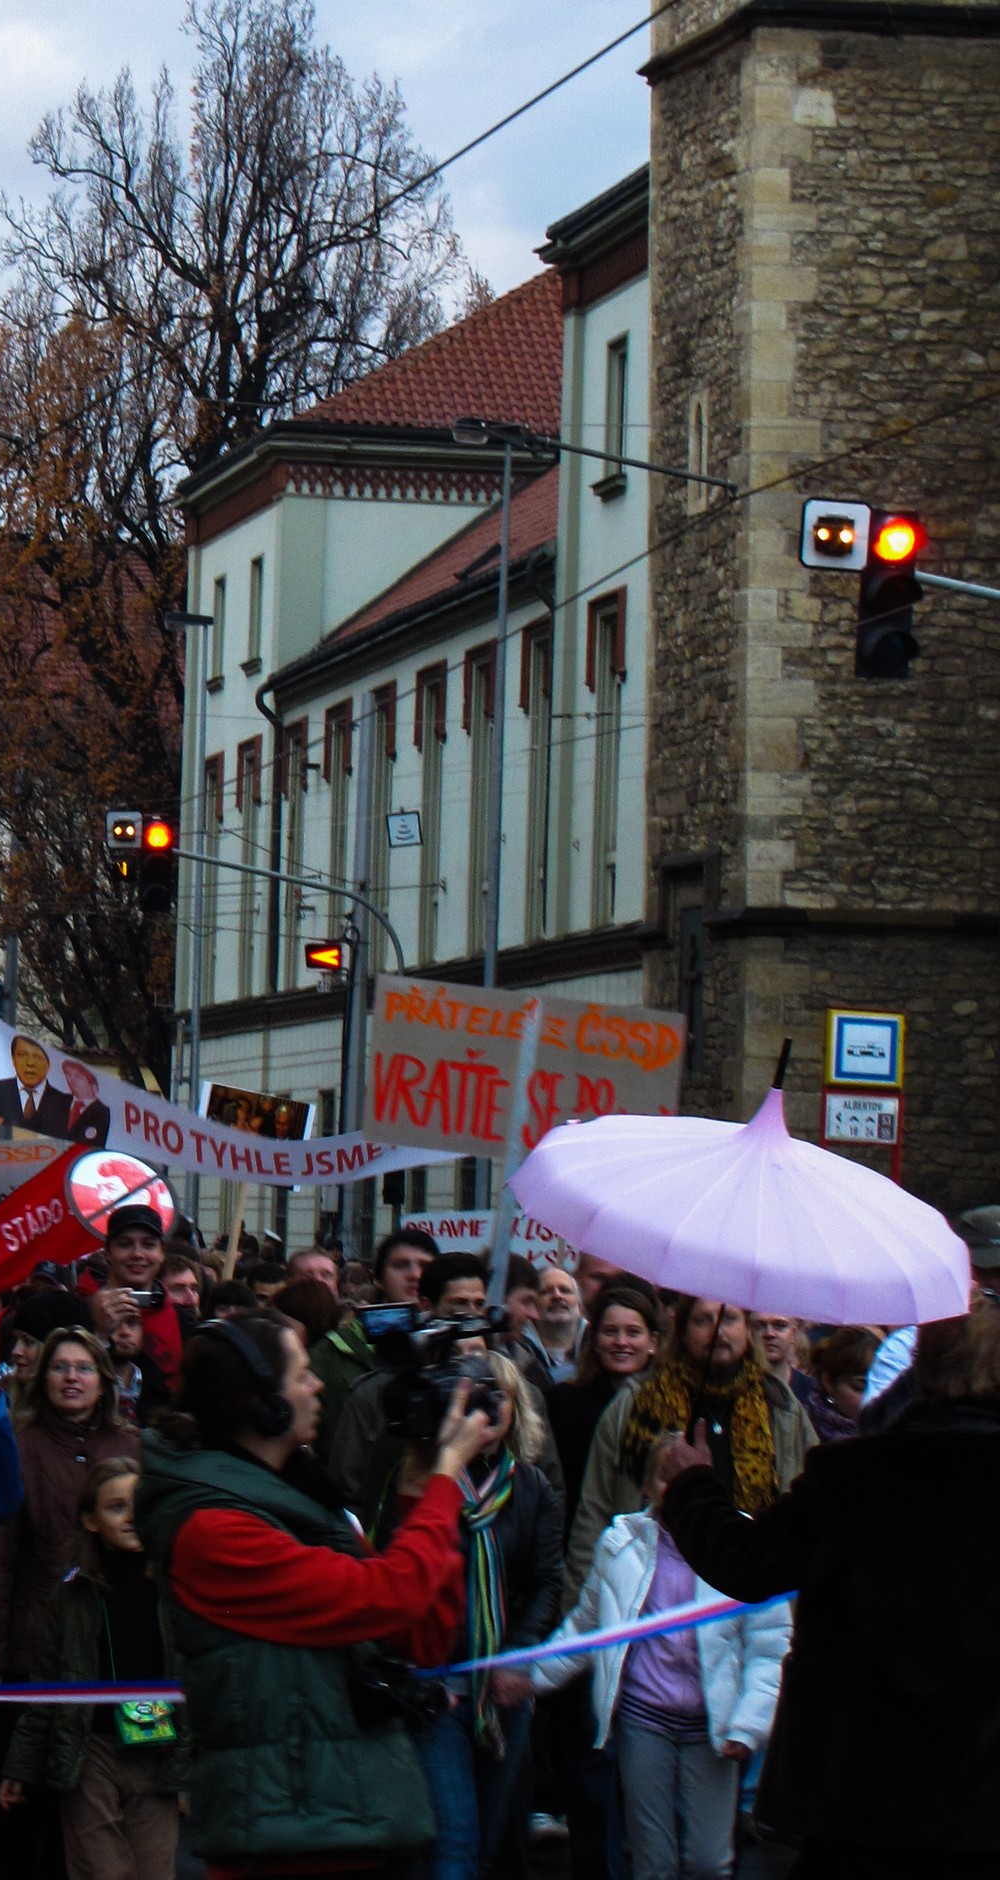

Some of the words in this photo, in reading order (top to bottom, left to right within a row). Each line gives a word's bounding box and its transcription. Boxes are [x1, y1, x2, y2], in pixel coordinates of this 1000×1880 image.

[576, 1002, 681, 1072] ČSSD
[124, 1101, 183, 1155] PRO
[190, 1131, 292, 1176] TYHLE
